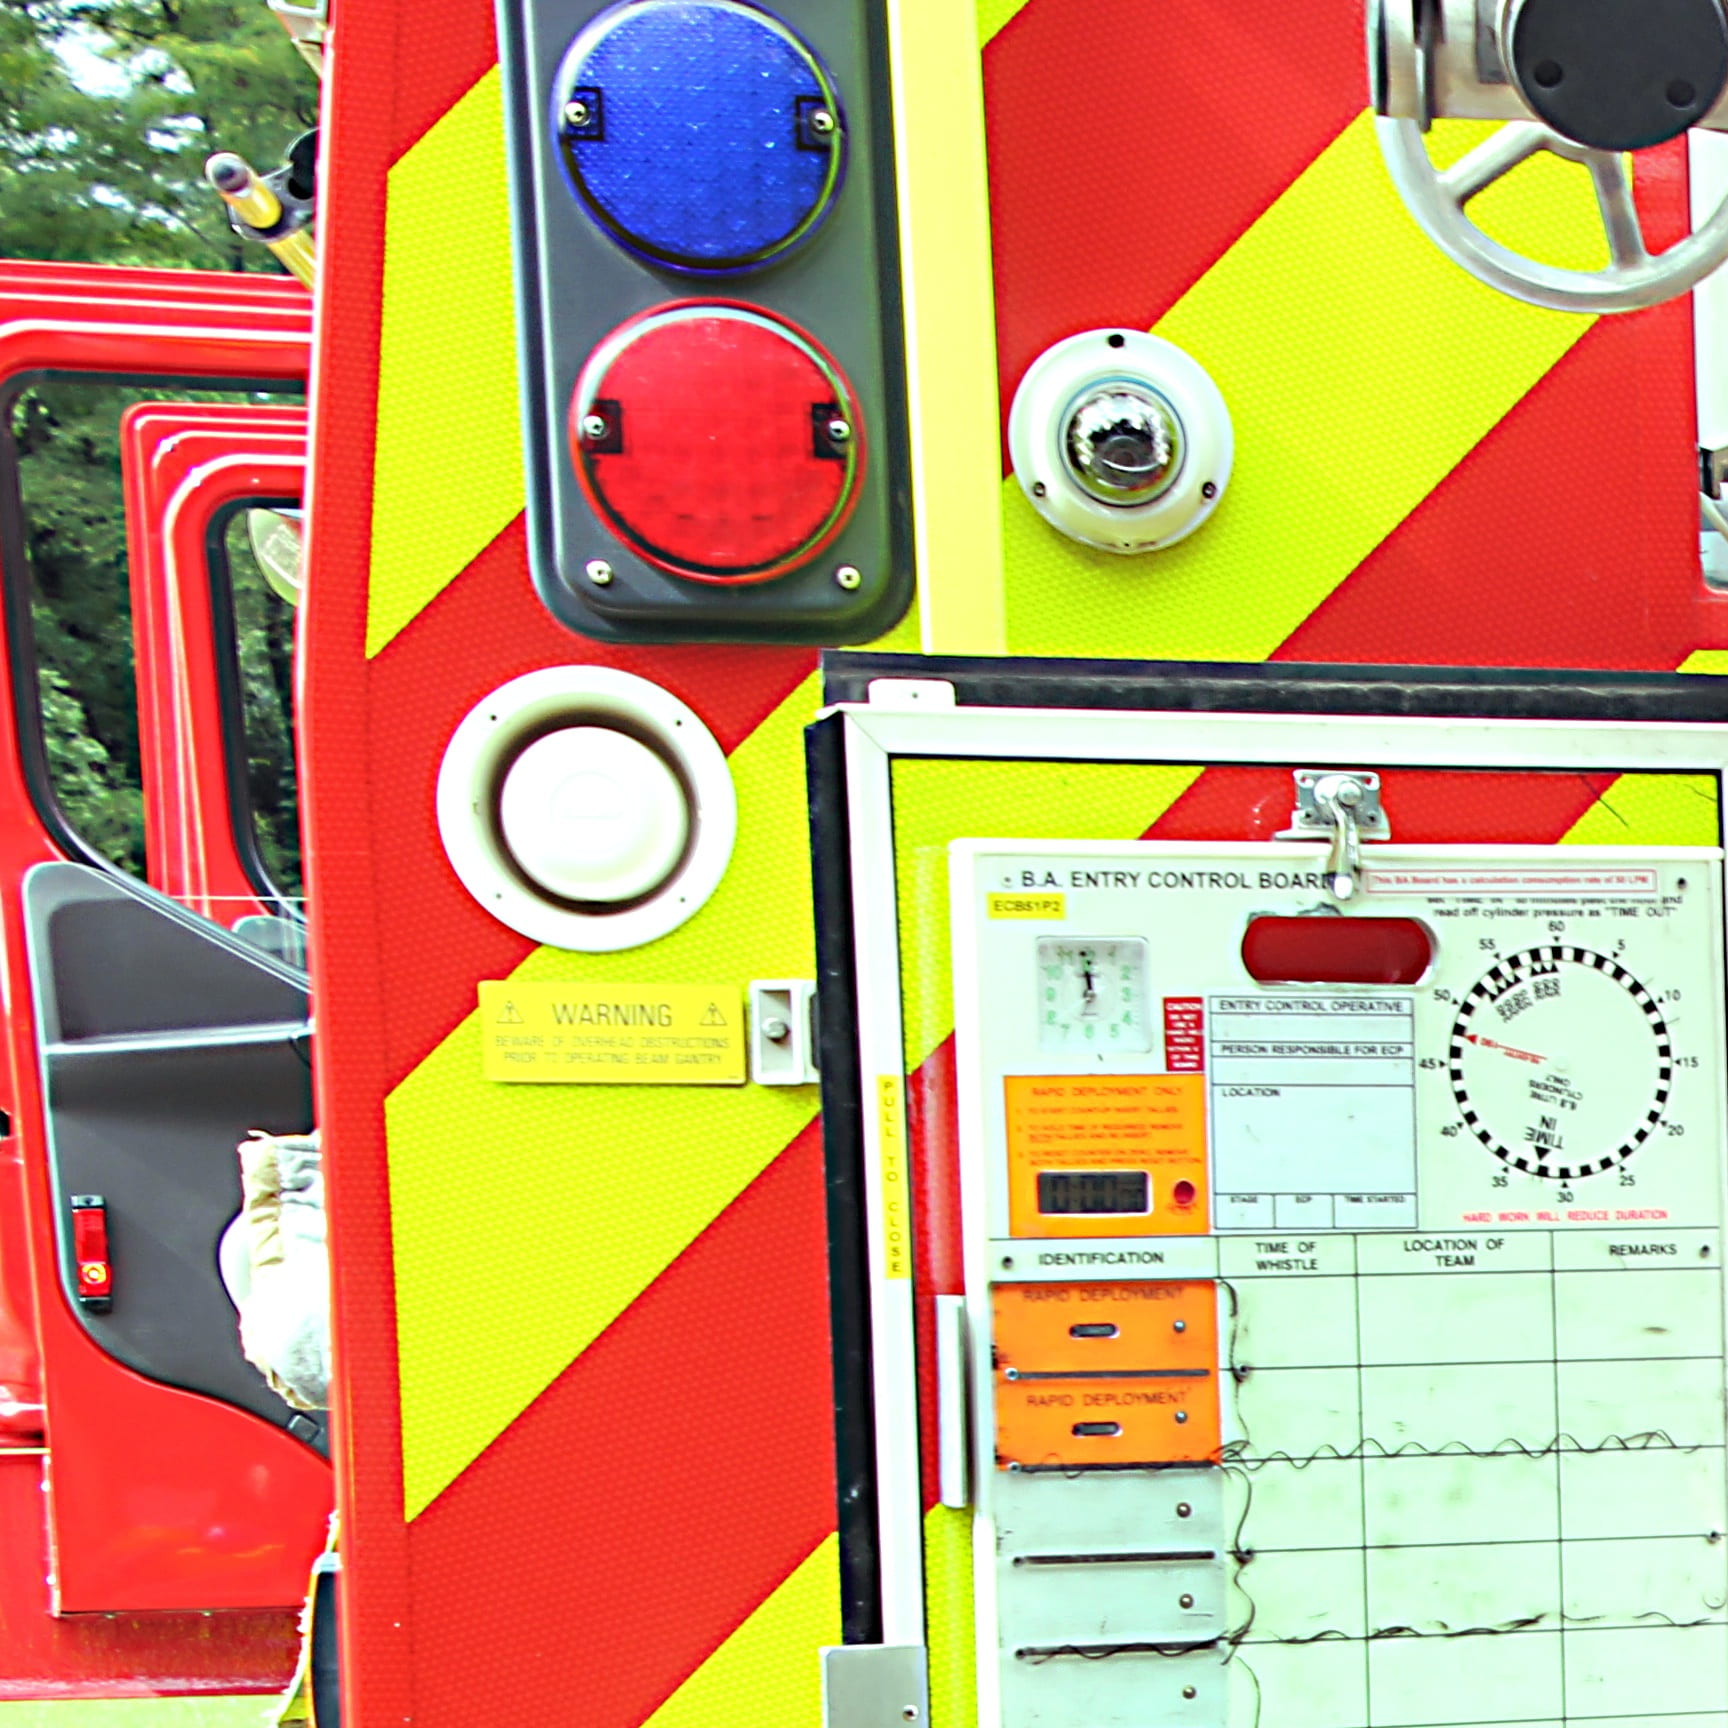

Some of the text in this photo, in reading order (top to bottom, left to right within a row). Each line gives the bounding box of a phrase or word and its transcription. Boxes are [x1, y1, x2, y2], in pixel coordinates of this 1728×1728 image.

[1021, 872, 1063, 888] B.A.
[1071, 872, 1140, 888] ENTRY
[1148, 872, 1251, 889] CONTROL
[1434, 907, 1459, 917] read
[1463, 907, 1479, 917] off
[1483, 907, 1529, 919] cylinder
[1533, 908, 1584, 919] pressure
[1588, 909, 1600, 917] as
[1549, 921, 1564, 932] 60
[1617, 940, 1625, 950] 5
[1434, 989, 1450, 1001] 50
[1665, 990, 1681, 1001] 10
[1220, 1001, 1403, 1012] ENTRY CONTROL OPERATIVE
[552, 1003, 672, 1027] WARNING
[496, 1036, 729, 1048] BEWARE OF OVERHEAD OBSTRUCTIONS
[1222, 1046, 1404, 1055] PERSON RESPONSIBLE FOR ECP
[504, 1052, 535, 1062] PRIOR
[565, 1053, 629, 1063] OPERATING
[636, 1053, 669, 1063] BEAM
[675, 1054, 721, 1064] GANTRY
[1419, 1059, 1436, 1069] 45
[1682, 1057, 1698, 1067] 15
[1223, 1088, 1280, 1097] LOCATION
[1440, 1125, 1458, 1137] 40
[1668, 1125, 1684, 1136] 20
[1524, 1127, 1565, 1150] TIME
[883, 1081, 901, 1273] PULL TO CLOSE
[1492, 1175, 1508, 1187] 35
[1620, 1175, 1635, 1186] 25
[1558, 1191, 1574, 1203] 30
[1498, 1212, 1530, 1222] WORK
[1537, 1211, 1559, 1221] WILL
[1568, 1210, 1609, 1221] REDUCE
[1615, 1209, 1668, 1220] DURATION
[1255, 1242, 1316, 1253] TIME OF
[1404, 1238, 1504, 1252] LOCATION OF
[1609, 1244, 1677, 1256] REMARKS
[1039, 1252, 1164, 1266] IDENTIFICATION
[1255, 1259, 1317, 1270] WHISTLE
[1436, 1255, 1475, 1266] TEAM
[1024, 1287, 1184, 1301] RAPID DEPLOYMENT
[1026, 1391, 1187, 1407] RAPID DEPLOYMENT
